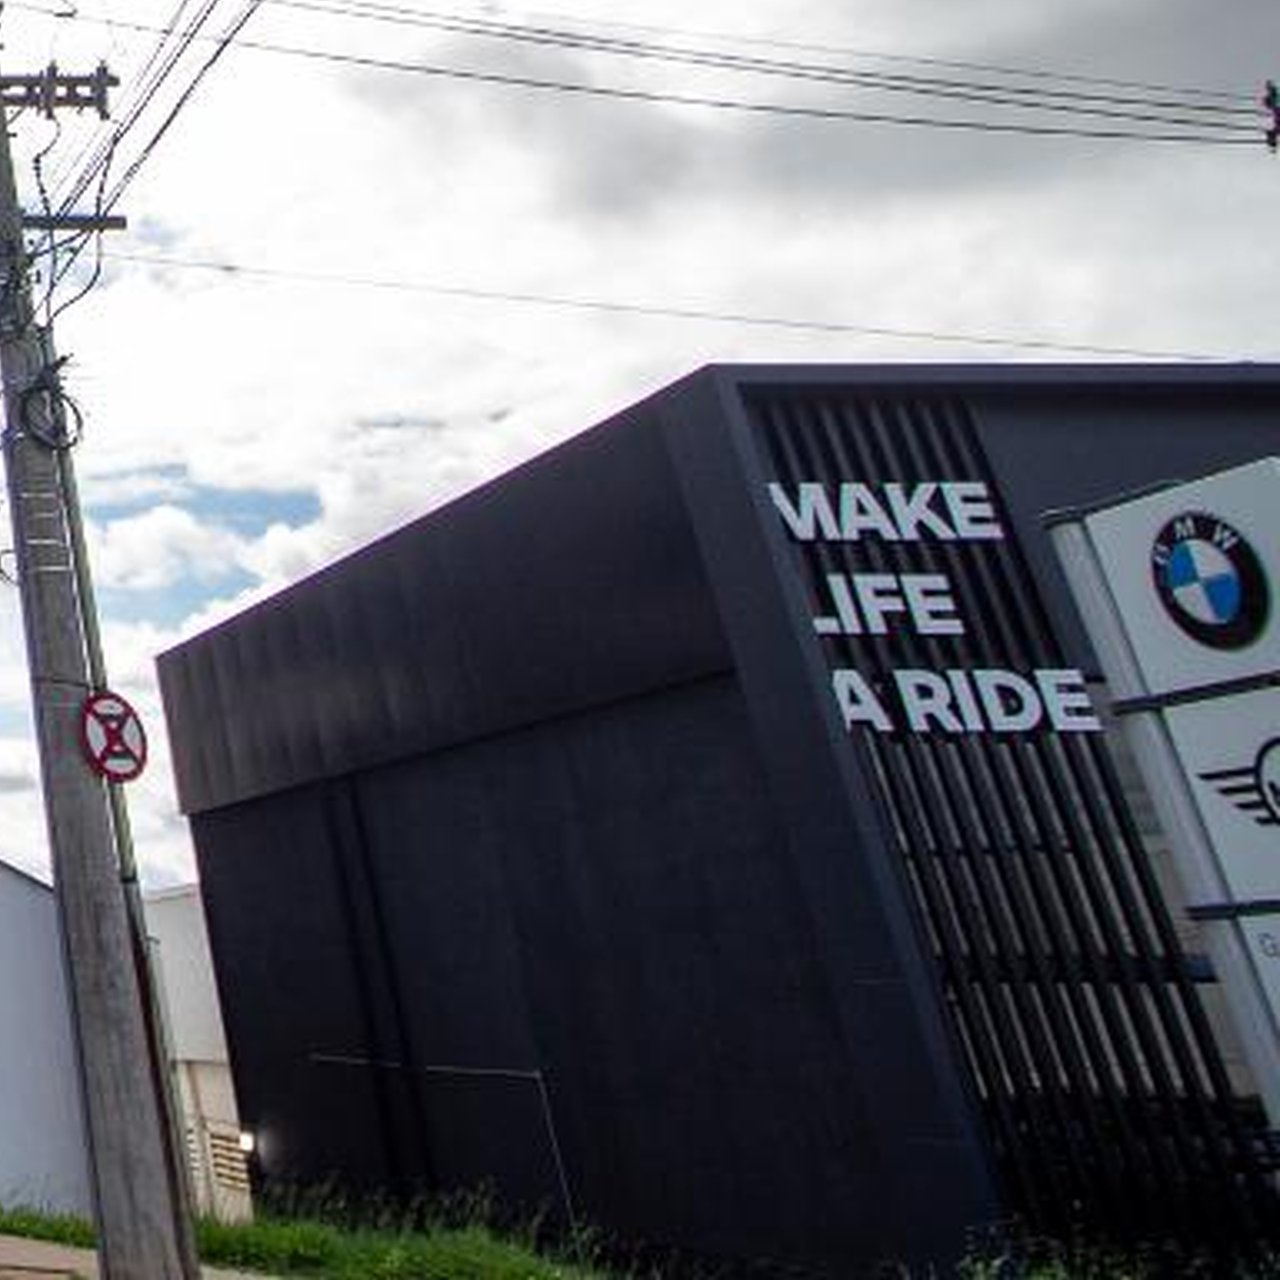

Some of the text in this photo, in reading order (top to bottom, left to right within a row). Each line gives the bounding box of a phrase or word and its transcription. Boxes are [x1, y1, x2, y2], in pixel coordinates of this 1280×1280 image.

[768, 481, 1005, 541] MAKE
[1153, 517, 1239, 565] BMW
[832, 669, 1103, 732] A RIDE
